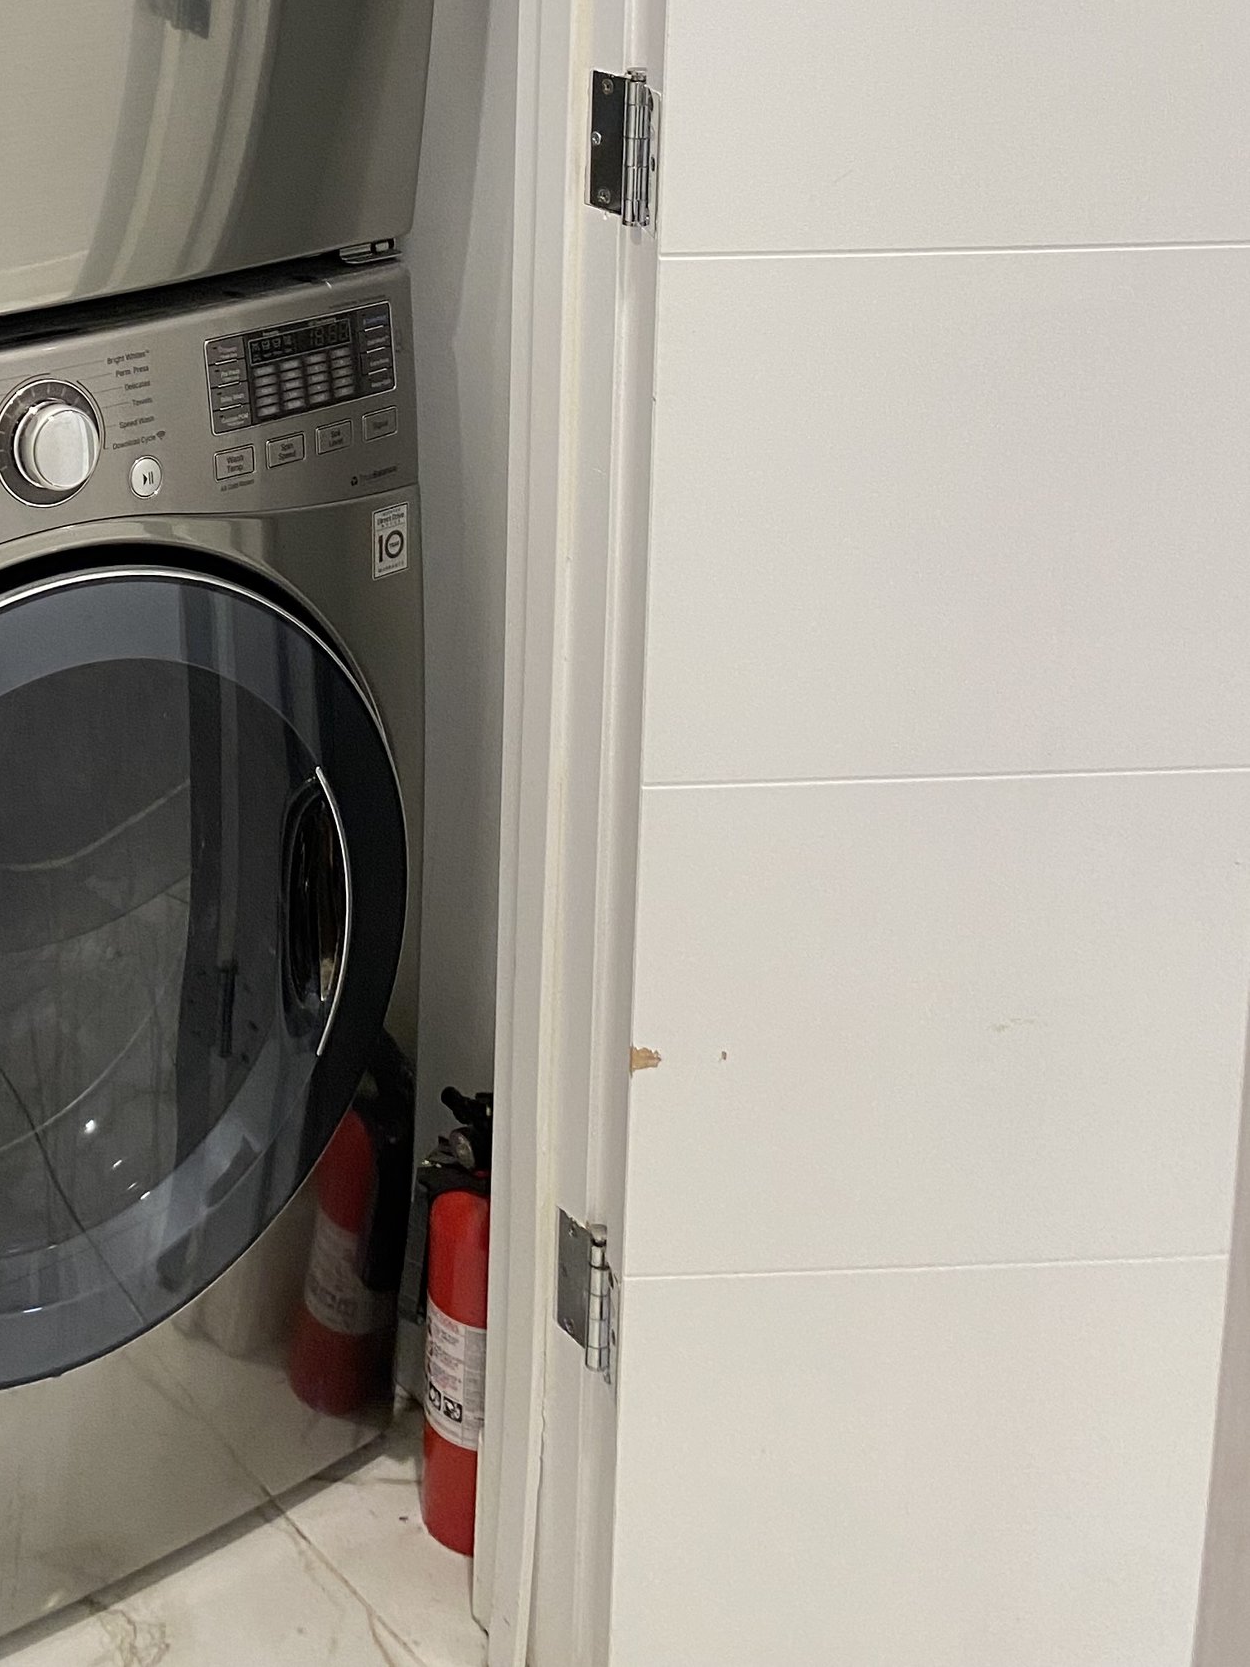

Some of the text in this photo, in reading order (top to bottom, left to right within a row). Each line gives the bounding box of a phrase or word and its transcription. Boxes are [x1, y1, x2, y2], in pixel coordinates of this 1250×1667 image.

[226, 454, 244, 465] Wash
[279, 449, 297, 461] Speed
[378, 529, 405, 563] 10
